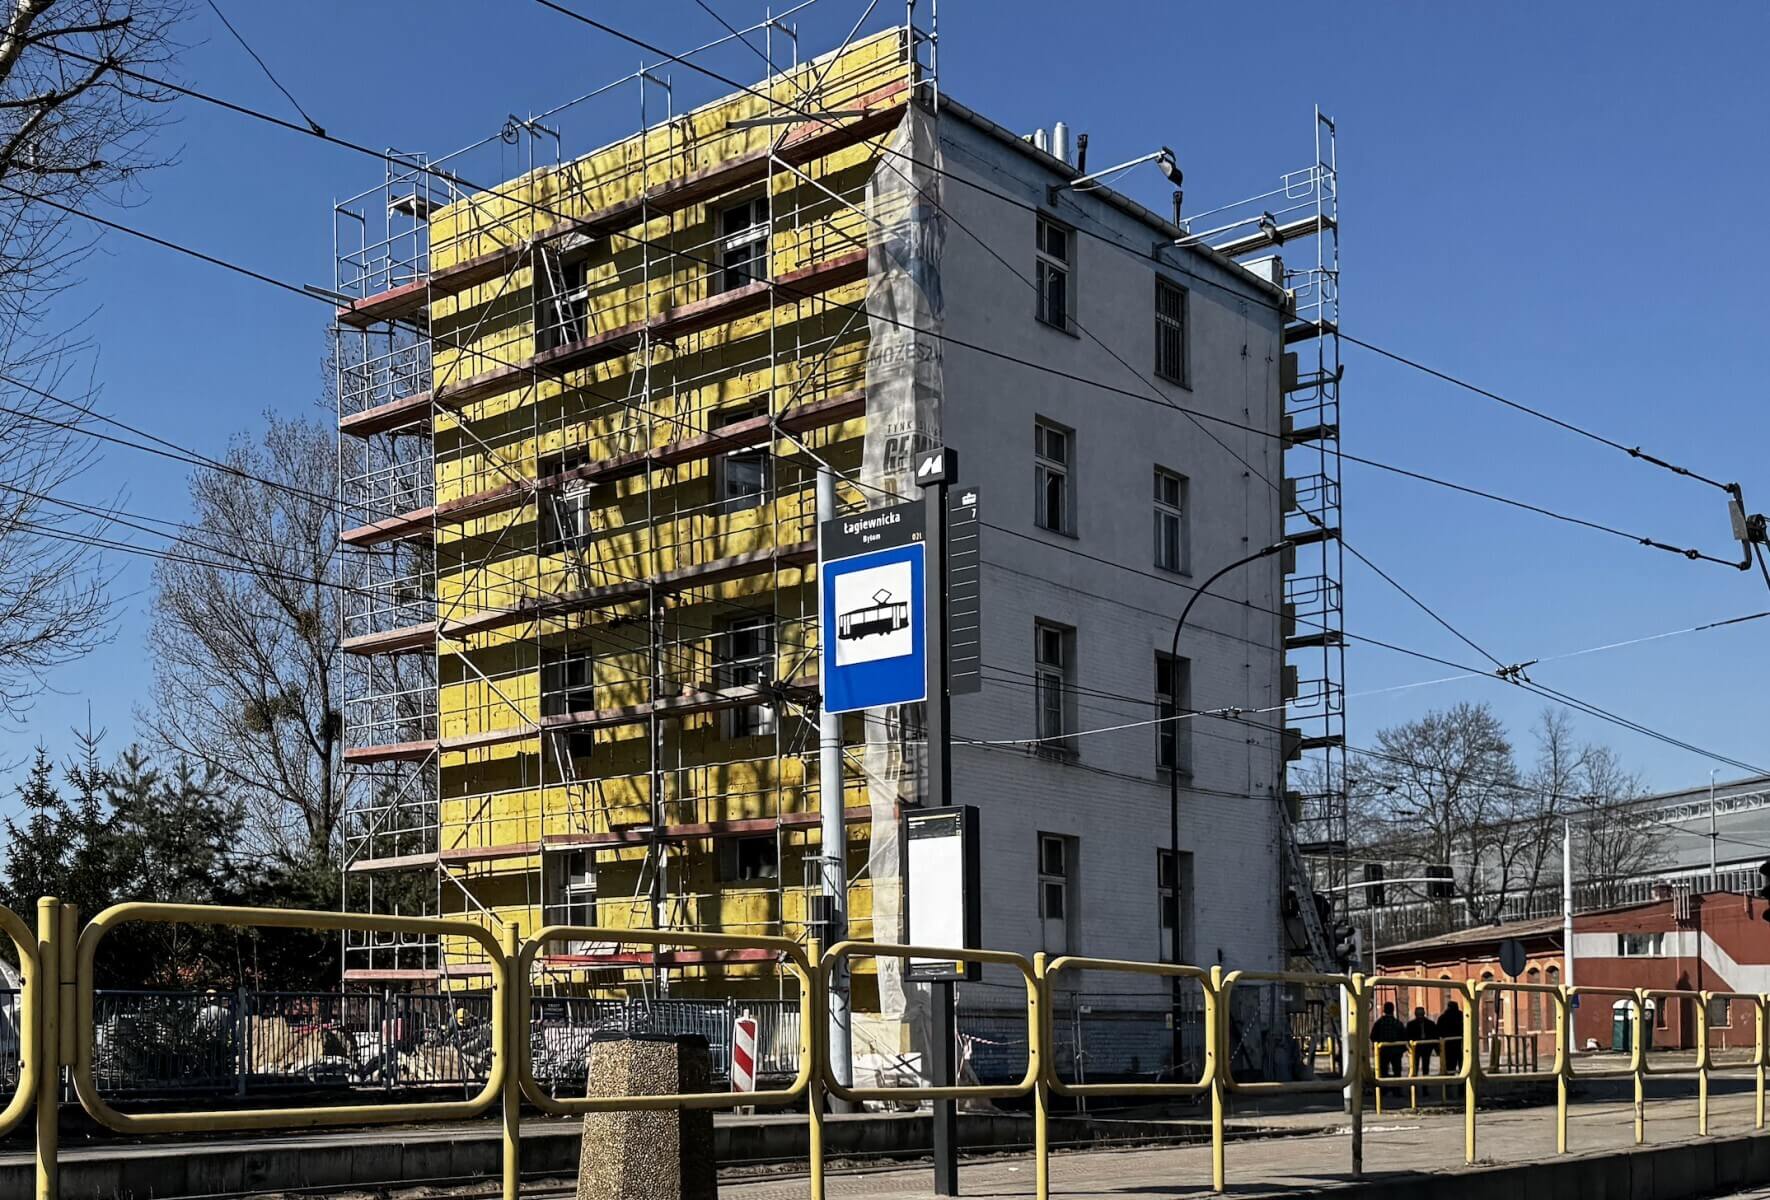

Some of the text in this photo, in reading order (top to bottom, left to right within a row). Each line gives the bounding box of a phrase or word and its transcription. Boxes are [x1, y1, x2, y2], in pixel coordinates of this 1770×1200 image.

[971, 508, 977, 519] 7
[843, 512, 901, 535] Łagiewnicka
[862, 533, 881, 544] Bytom
